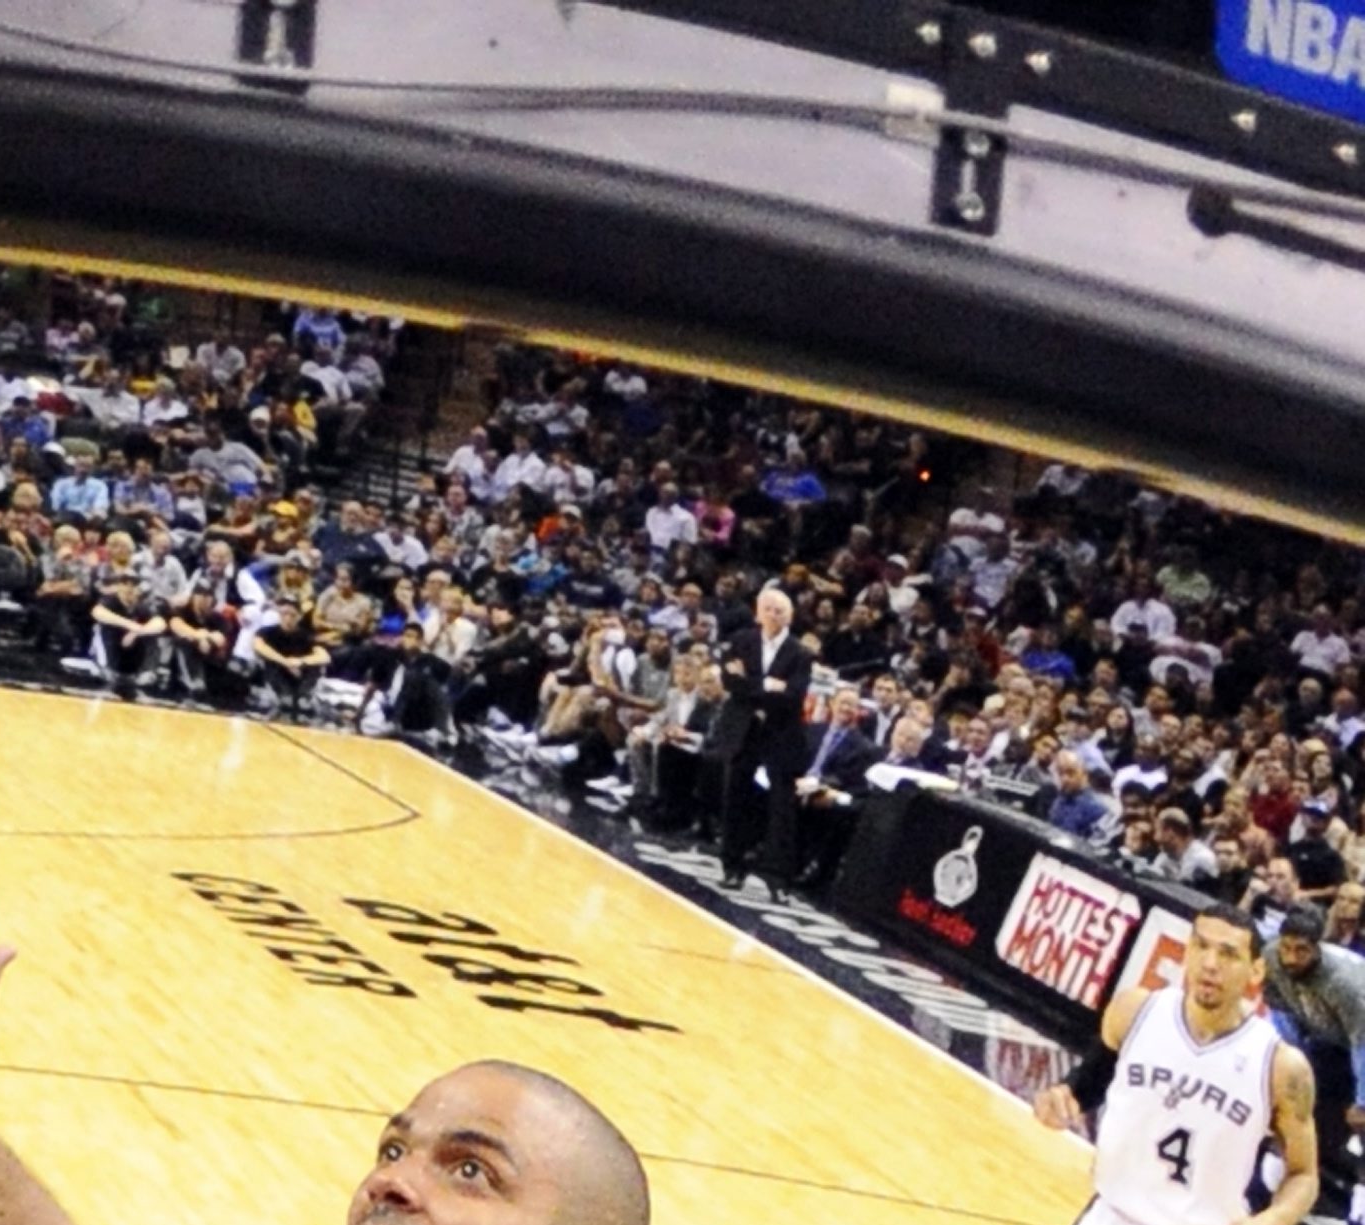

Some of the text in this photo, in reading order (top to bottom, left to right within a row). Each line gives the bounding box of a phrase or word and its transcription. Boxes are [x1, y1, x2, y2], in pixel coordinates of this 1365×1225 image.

[1246, 0, 1365, 90] NBA
[171, 872, 417, 998] CENTER
[1006, 917, 1117, 1011] MONTH
[1031, 871, 1141, 966] HOTTEST
[1127, 1063, 1253, 1127] SPURS
[1157, 1127, 1192, 1186] 4
